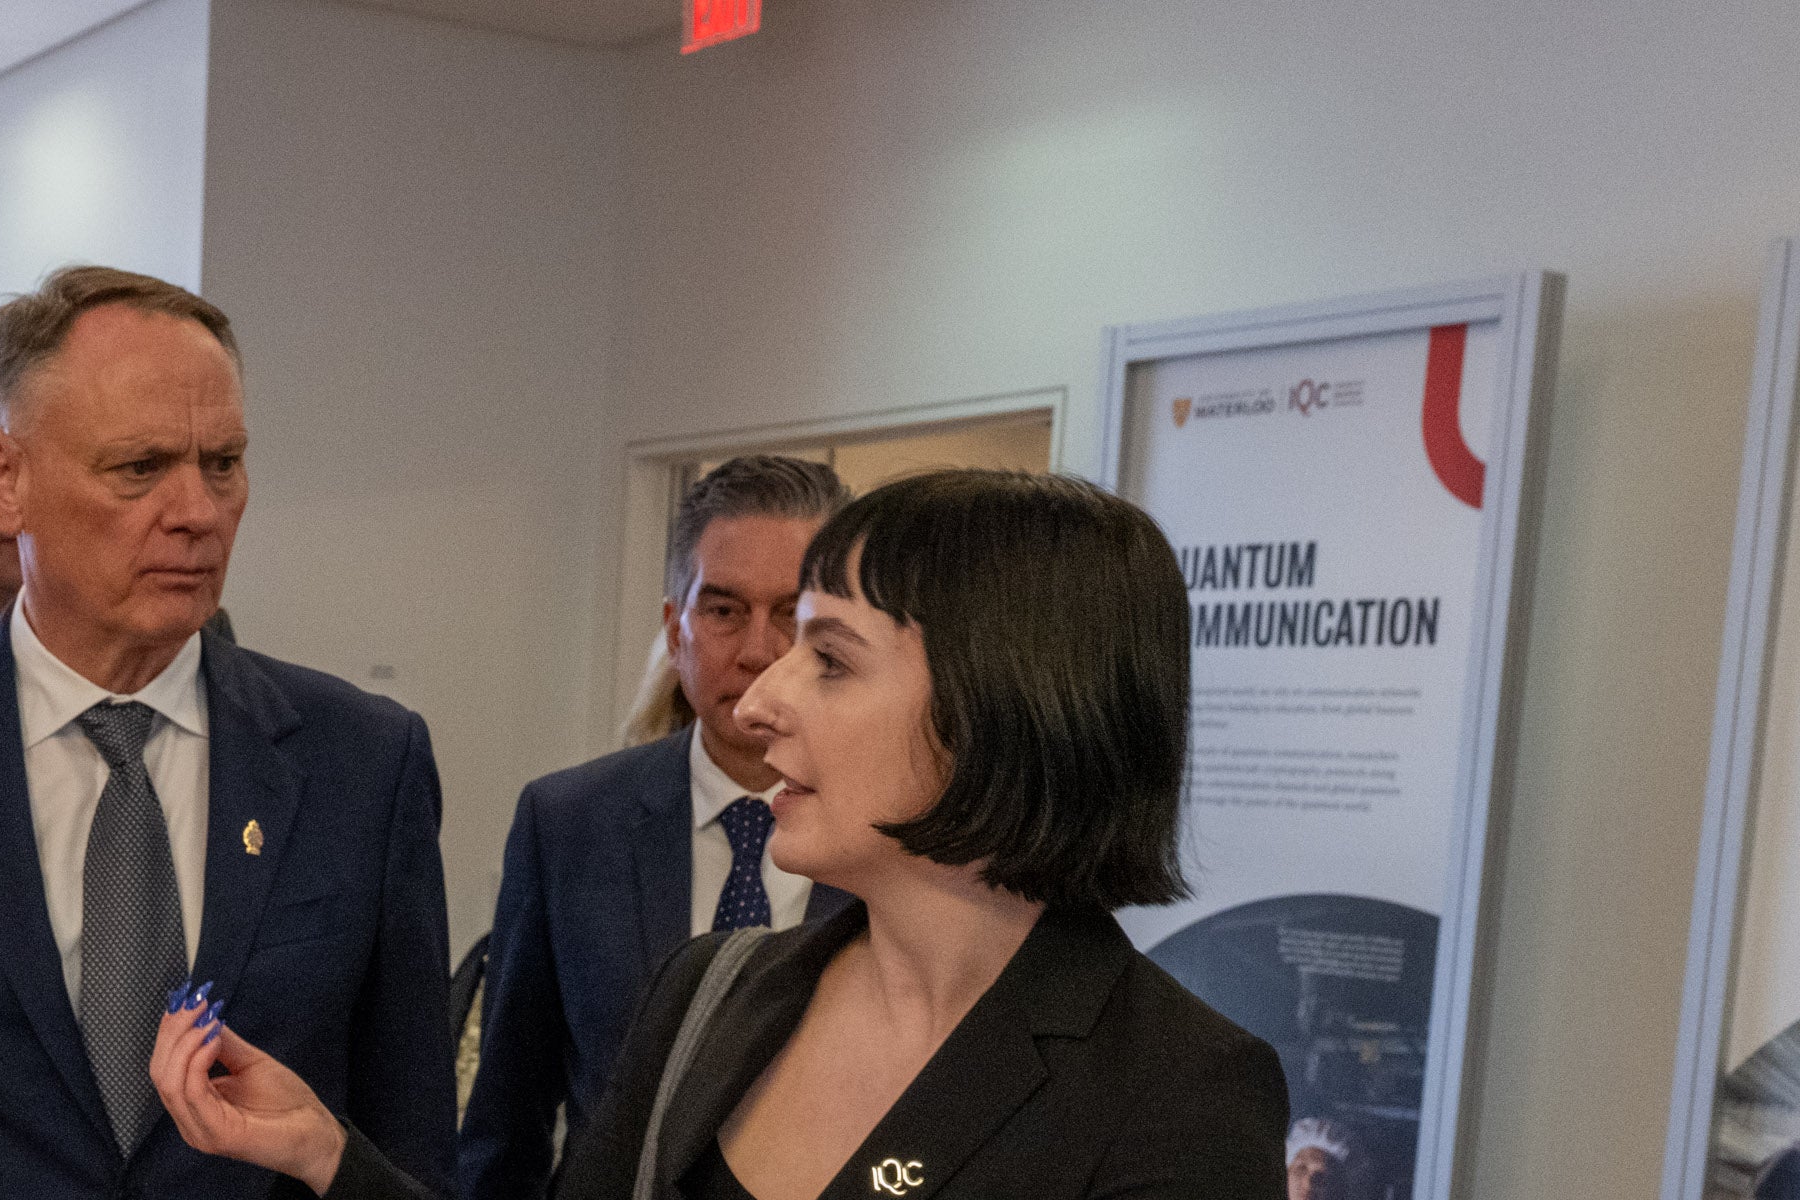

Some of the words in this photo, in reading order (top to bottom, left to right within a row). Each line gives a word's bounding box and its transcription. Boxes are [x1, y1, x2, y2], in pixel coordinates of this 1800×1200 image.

[1288, 378, 1330, 416] IQC
[1181, 540, 1317, 590] UANTUM
[1189, 597, 1439, 648] MMUNICATION
[871, 1158, 923, 1195] IQC
